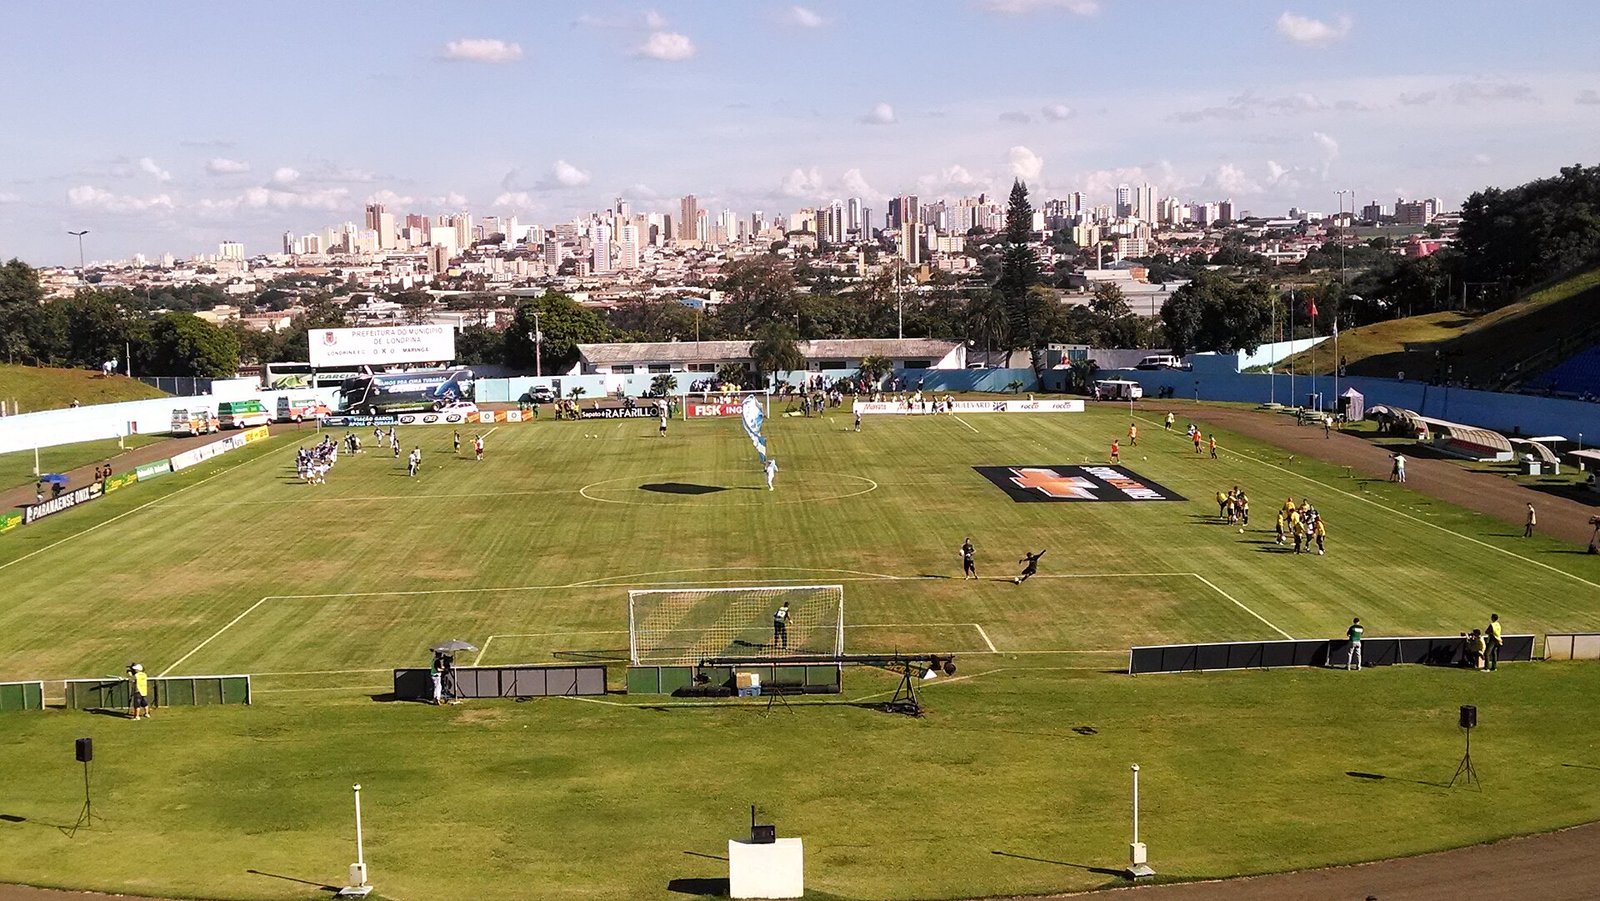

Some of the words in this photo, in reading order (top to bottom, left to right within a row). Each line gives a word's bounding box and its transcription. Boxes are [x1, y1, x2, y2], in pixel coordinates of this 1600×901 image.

[351, 329, 396, 337] PREFEITURA
[386, 336, 422, 344] LONDRINA
[581, 410, 600, 418] Sapato
[605, 407, 658, 418] RAFARILLO
[695, 404, 722, 416] FISK
[32, 491, 75, 520] PARANAENSE
[75, 487, 90, 504] ONIX
